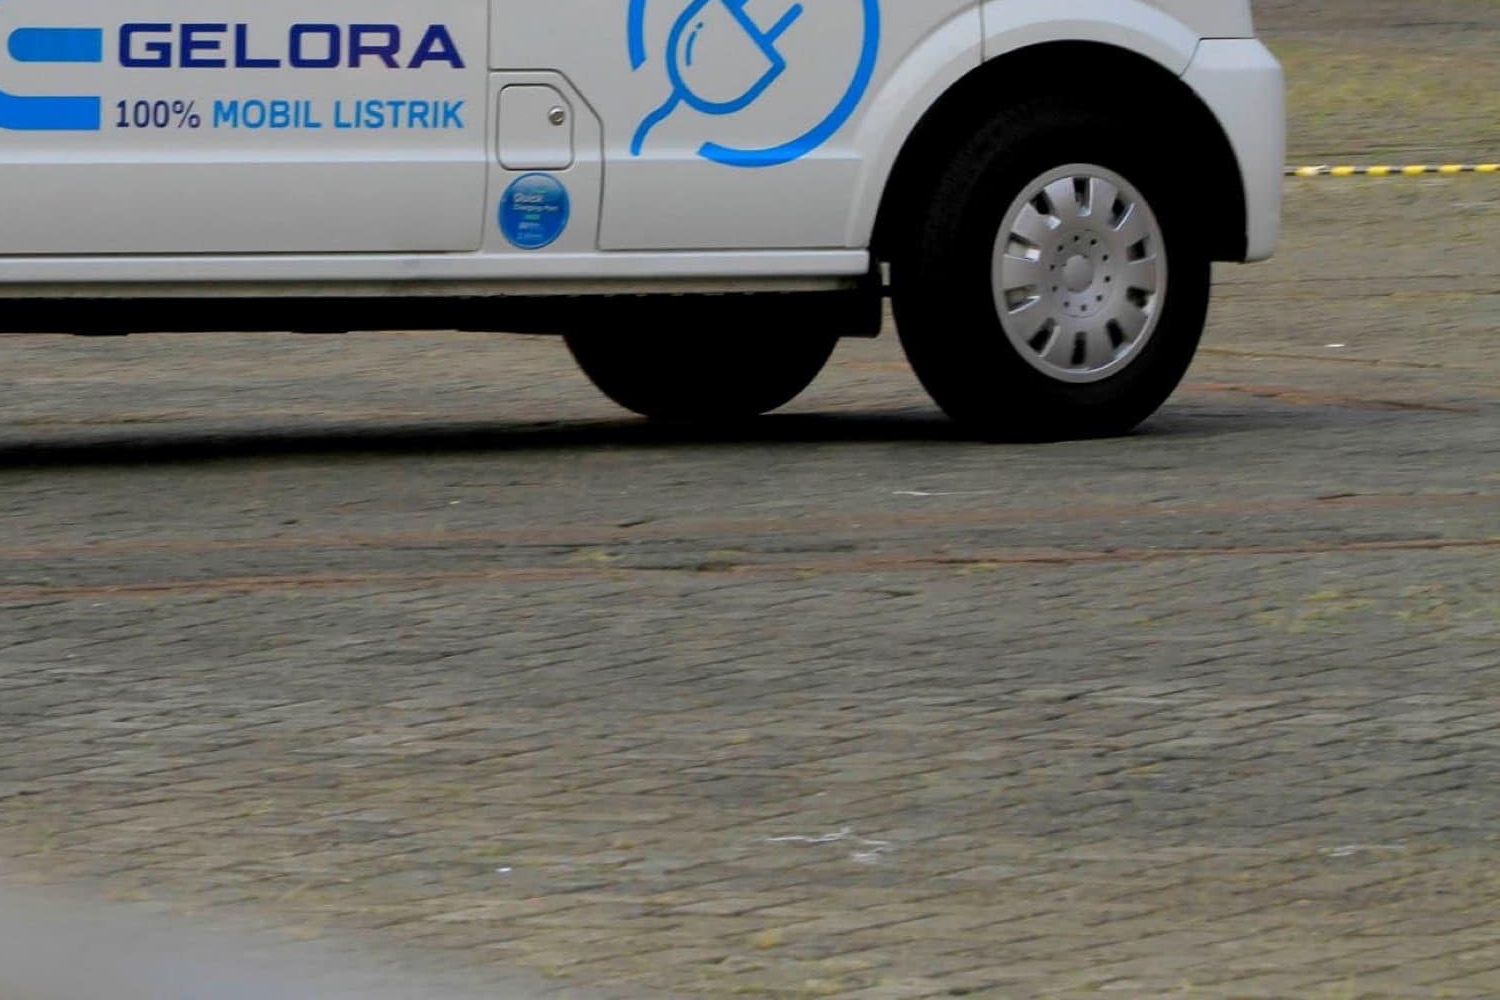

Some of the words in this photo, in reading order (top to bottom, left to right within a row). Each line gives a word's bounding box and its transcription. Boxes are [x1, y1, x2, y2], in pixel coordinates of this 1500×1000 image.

[117, 22, 466, 69] GELORA
[115, 100, 200, 129] 100%
[212, 100, 322, 129] MOBIL
[334, 101, 465, 129] LISTRIK
